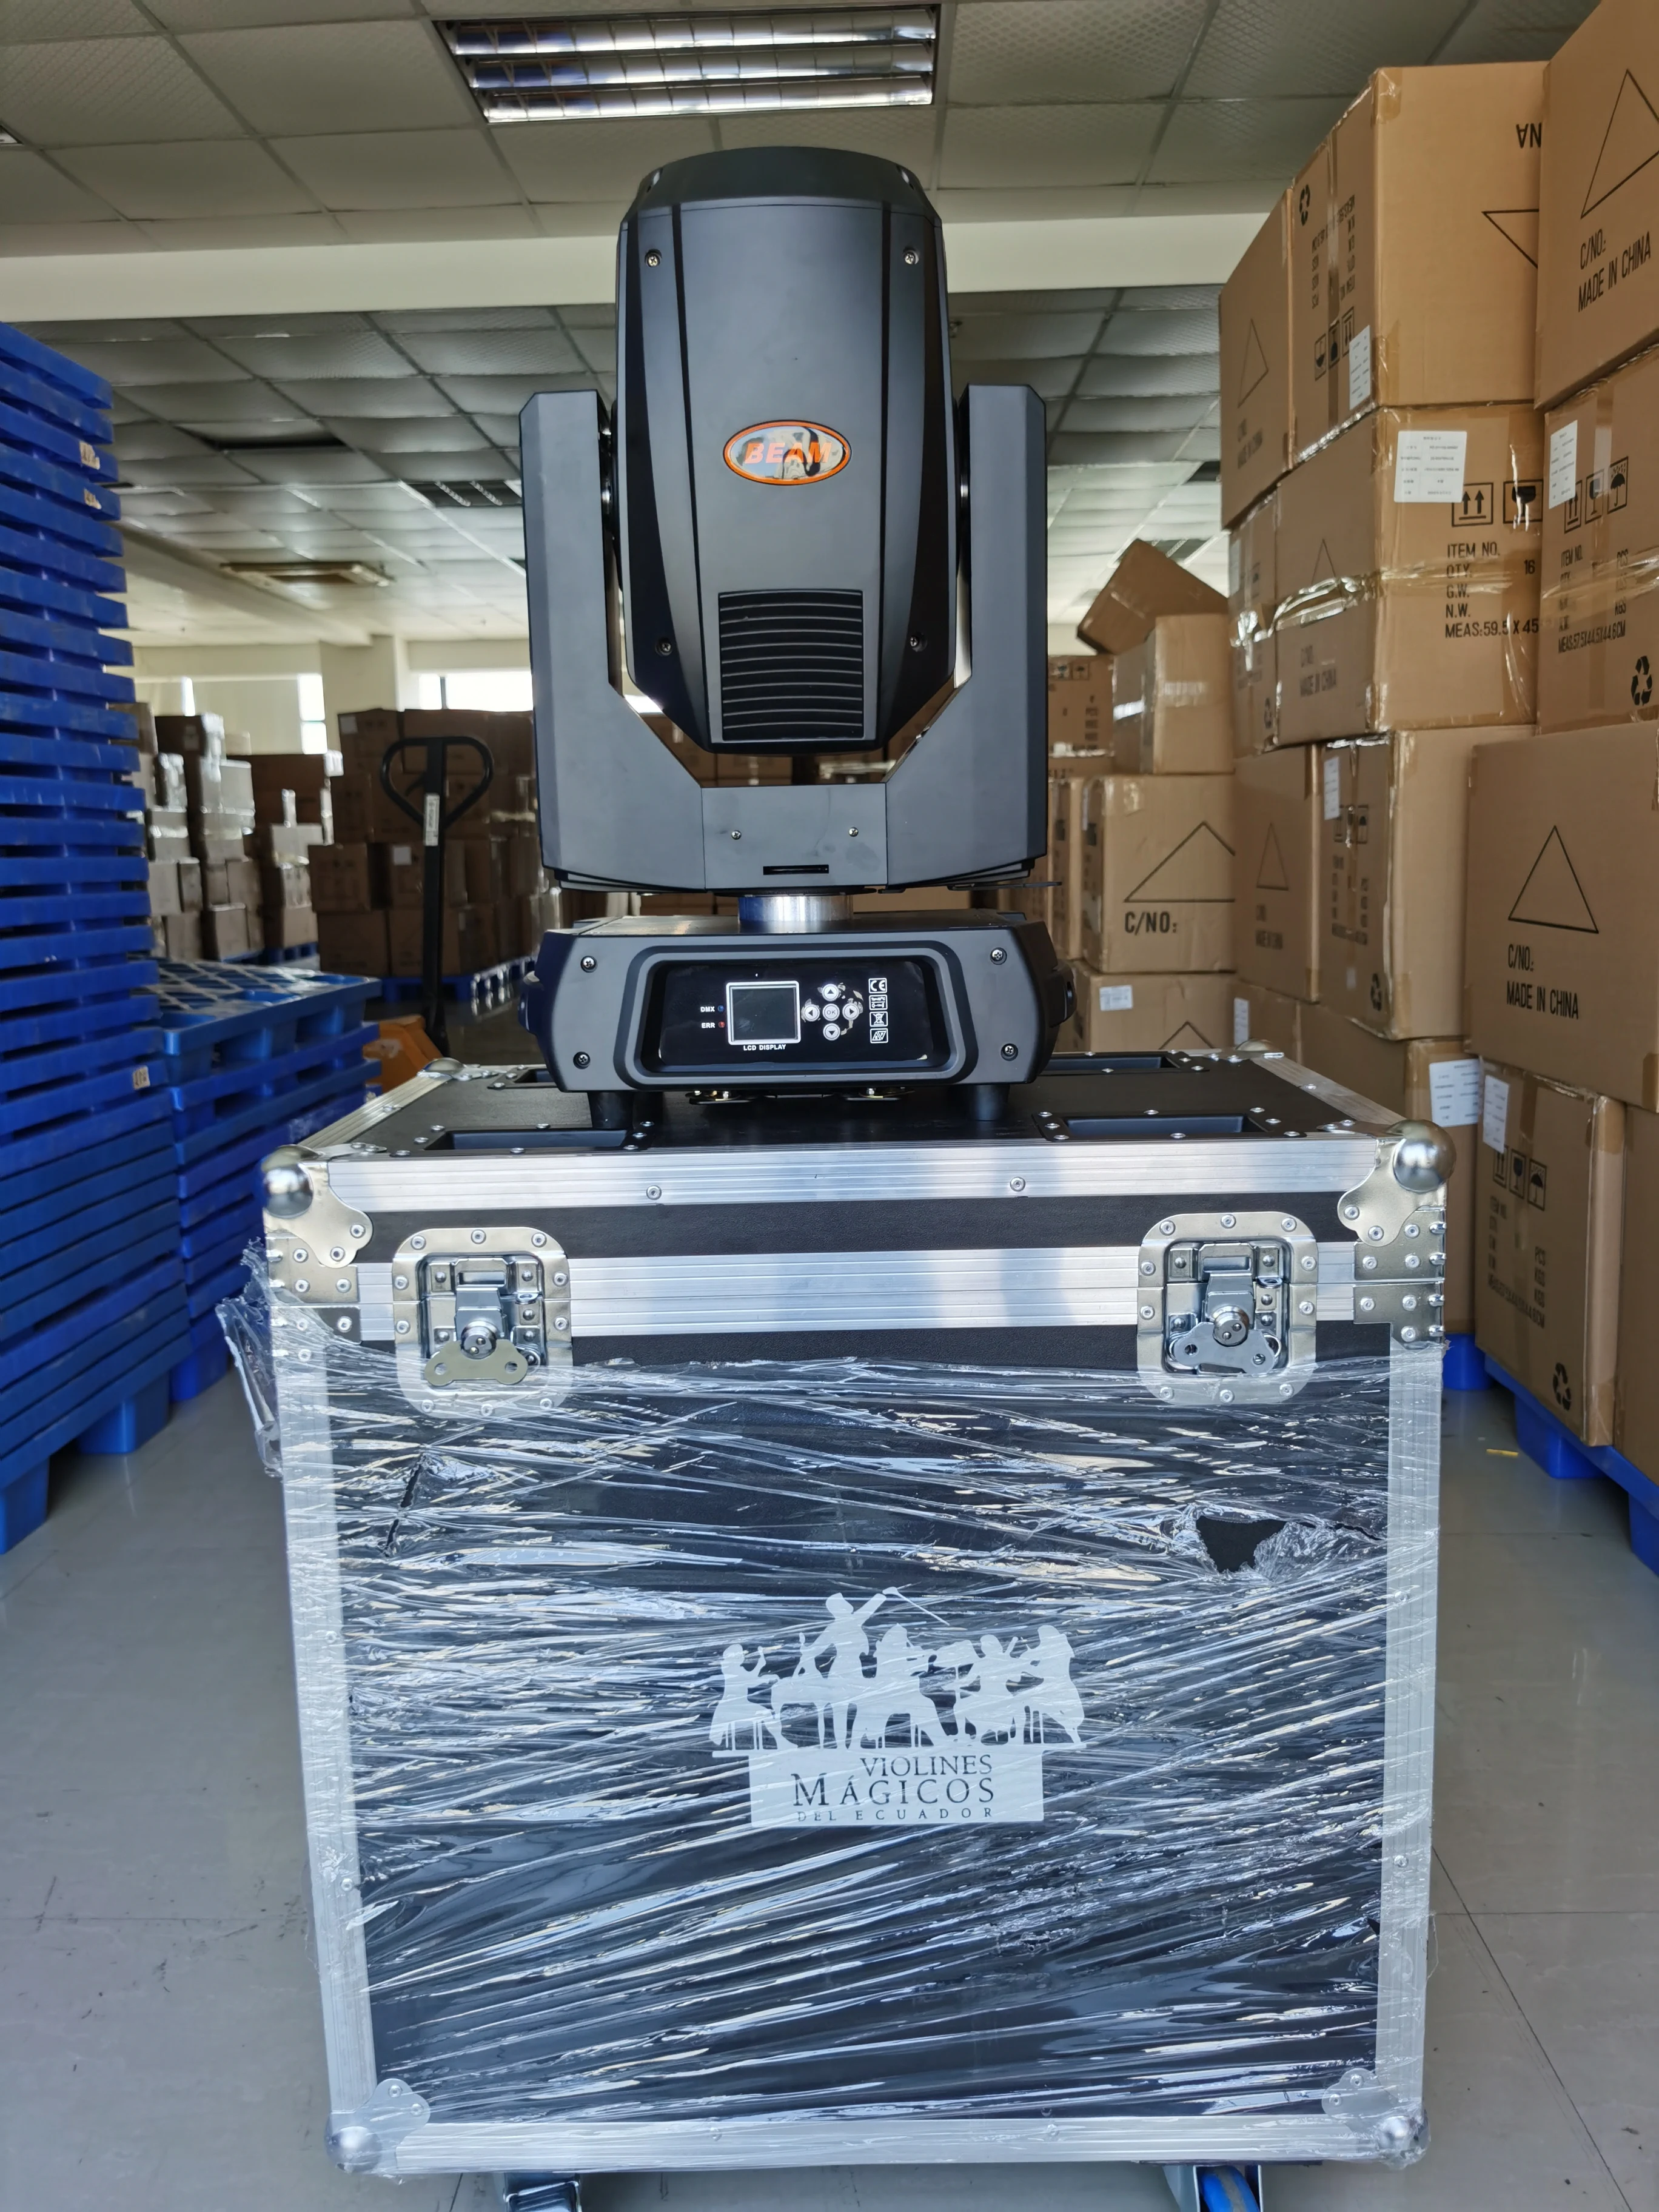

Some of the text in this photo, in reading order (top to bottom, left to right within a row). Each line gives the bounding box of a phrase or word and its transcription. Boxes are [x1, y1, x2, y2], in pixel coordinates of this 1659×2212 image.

[1578, 231, 1651, 312] MADE IN CHINA
[745, 442, 832, 464] BEAM
[1447, 541, 1500, 558] ITEM NO.
[1524, 559, 1535, 575] 16
[1446, 583, 1470, 598] G.W.
[1446, 603, 1470, 618] N.W.
[1125, 911, 1177, 936] C/NO:
[870, 980, 886, 991] CE
[1506, 980, 1578, 1020] MADE IN CHINA
[860, 1754, 993, 1777] VIOLINES
[791, 1772, 994, 1806] MÁGICOS
[797, 1806, 993, 1822] DEL ECUADOR
